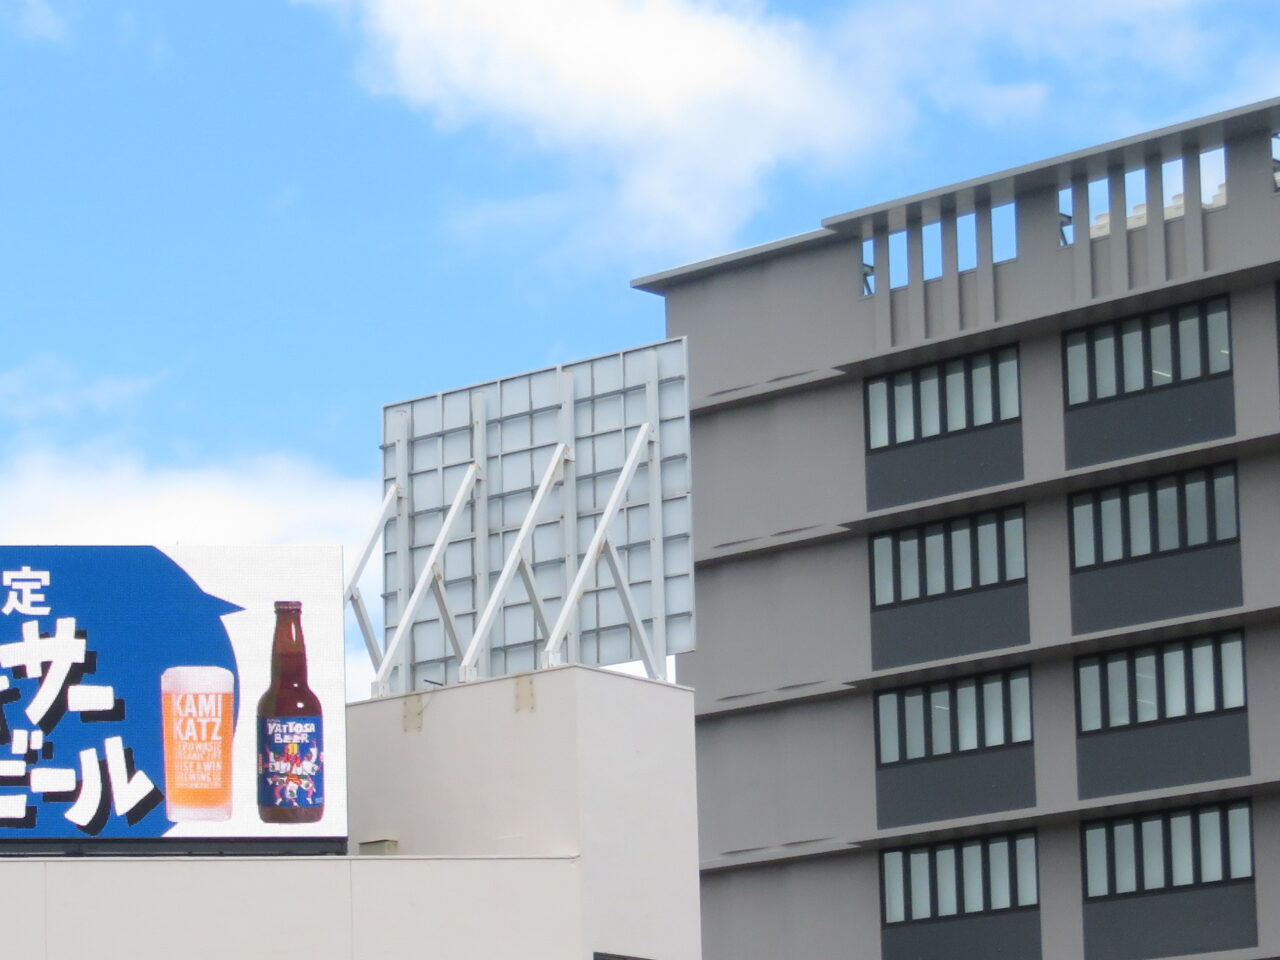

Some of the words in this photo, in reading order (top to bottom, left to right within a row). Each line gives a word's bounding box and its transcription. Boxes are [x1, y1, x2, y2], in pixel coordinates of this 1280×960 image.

[172, 693, 223, 718] KAMI
[173, 717, 223, 741] KATZ
[274, 733, 310, 744] BEER
